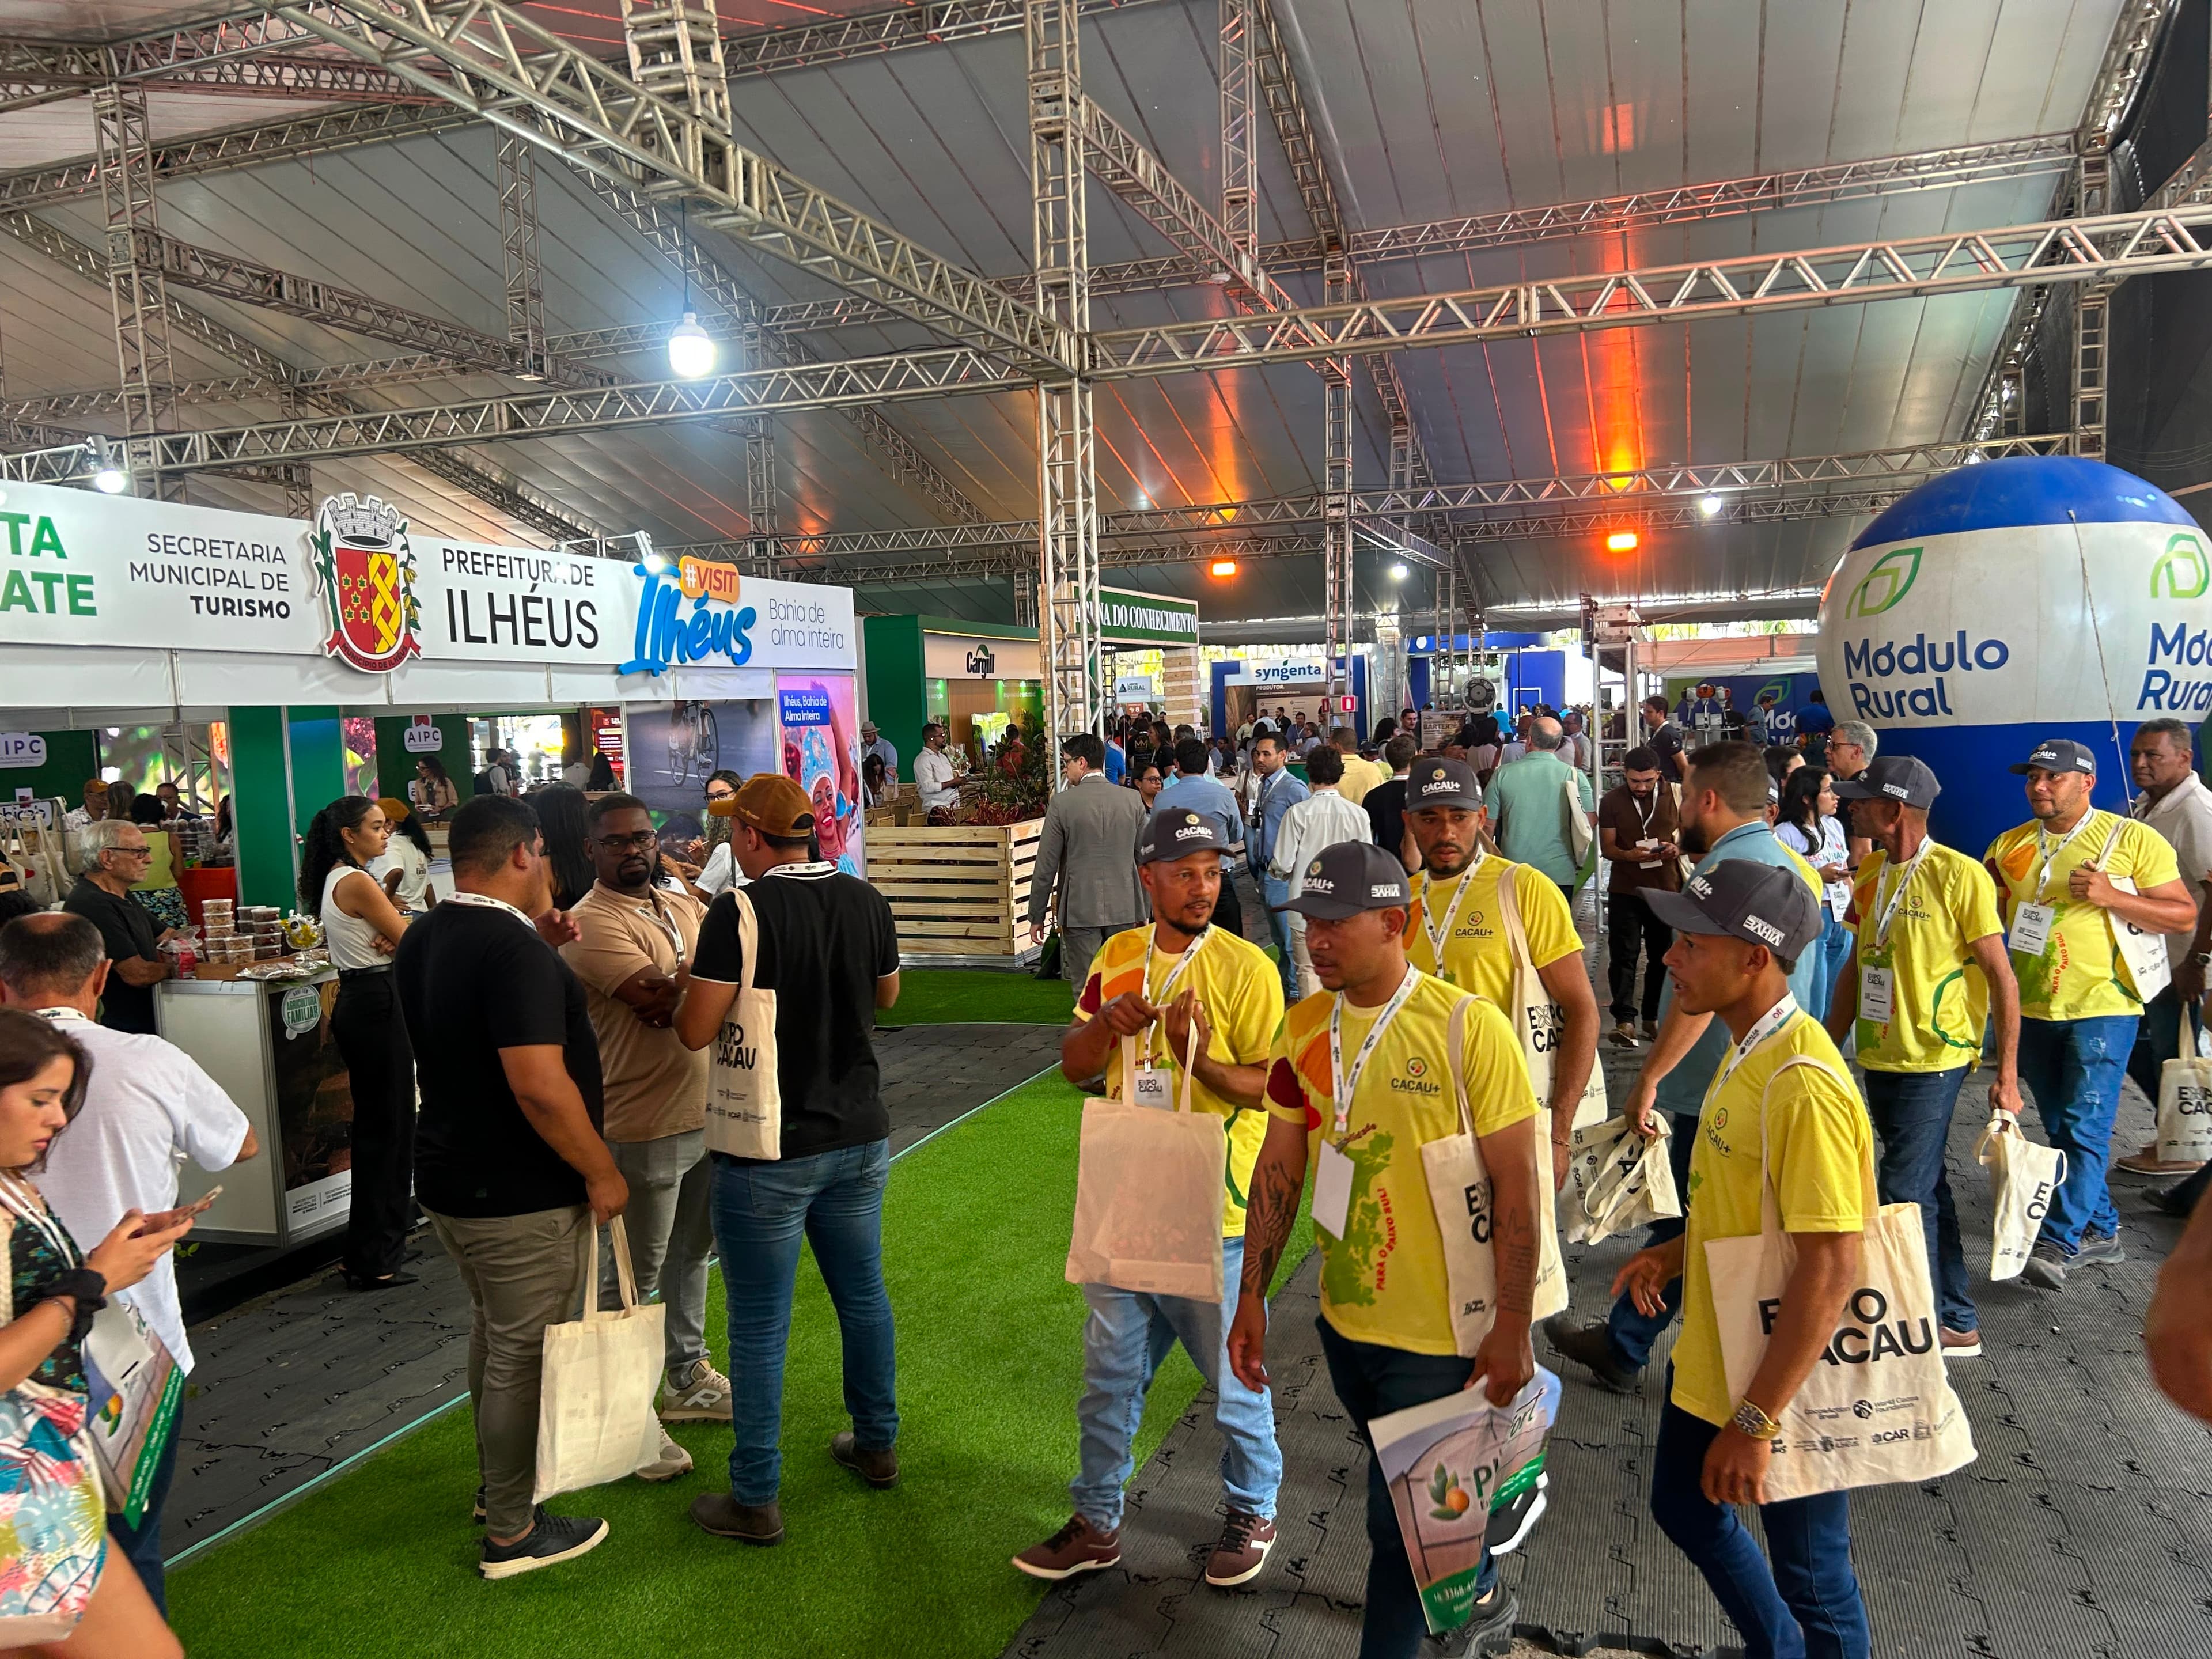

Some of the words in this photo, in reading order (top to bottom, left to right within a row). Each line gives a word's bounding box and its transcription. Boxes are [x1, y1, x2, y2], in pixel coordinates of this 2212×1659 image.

[148, 533, 286, 565] SECRETARIA
[130, 562, 255, 590] MUNICIPAL
[262, 571, 289, 592] DE
[442, 548, 570, 583] PREFEITURA
[572, 565, 594, 586] DE
[684, 563, 736, 593] #VISIT
[0, 569, 97, 616] ATE
[190, 596, 289, 619] TURISMO
[446, 584, 598, 649] ILHÉUS
[618, 563, 757, 677] Ilhéus
[769, 598, 805, 622] Bahia
[808, 602, 825, 624] de
[1112, 604, 1128, 627] DO
[1129, 606, 1197, 634] CONHECIMENTO
[771, 624, 805, 646] alma
[808, 626, 844, 650] inteira
[966, 652, 995, 679] Cargill
[1844, 630, 2009, 680] Módulo
[1255, 664, 1321, 681] syngenta
[783, 695, 802, 708] Ilhéus,
[802, 696, 819, 707] Bahia
[819, 696, 827, 707] de
[1848, 677, 1952, 719] Rural
[785, 710, 800, 721] Alma
[801, 710, 820, 721] Inteira
[408, 730, 440, 743] AIPC
[1422, 781, 1460, 793] CACAU+
[1898, 908, 1931, 919] CACAU+
[1455, 928, 1494, 937] CACAU+
[287, 1005, 319, 1024] FAMILIAR
[1391, 1077, 1440, 1093] CACAU+
[1376, 1262, 1385, 1291] PARA
[1883, 1429, 1910, 1441] CAR
